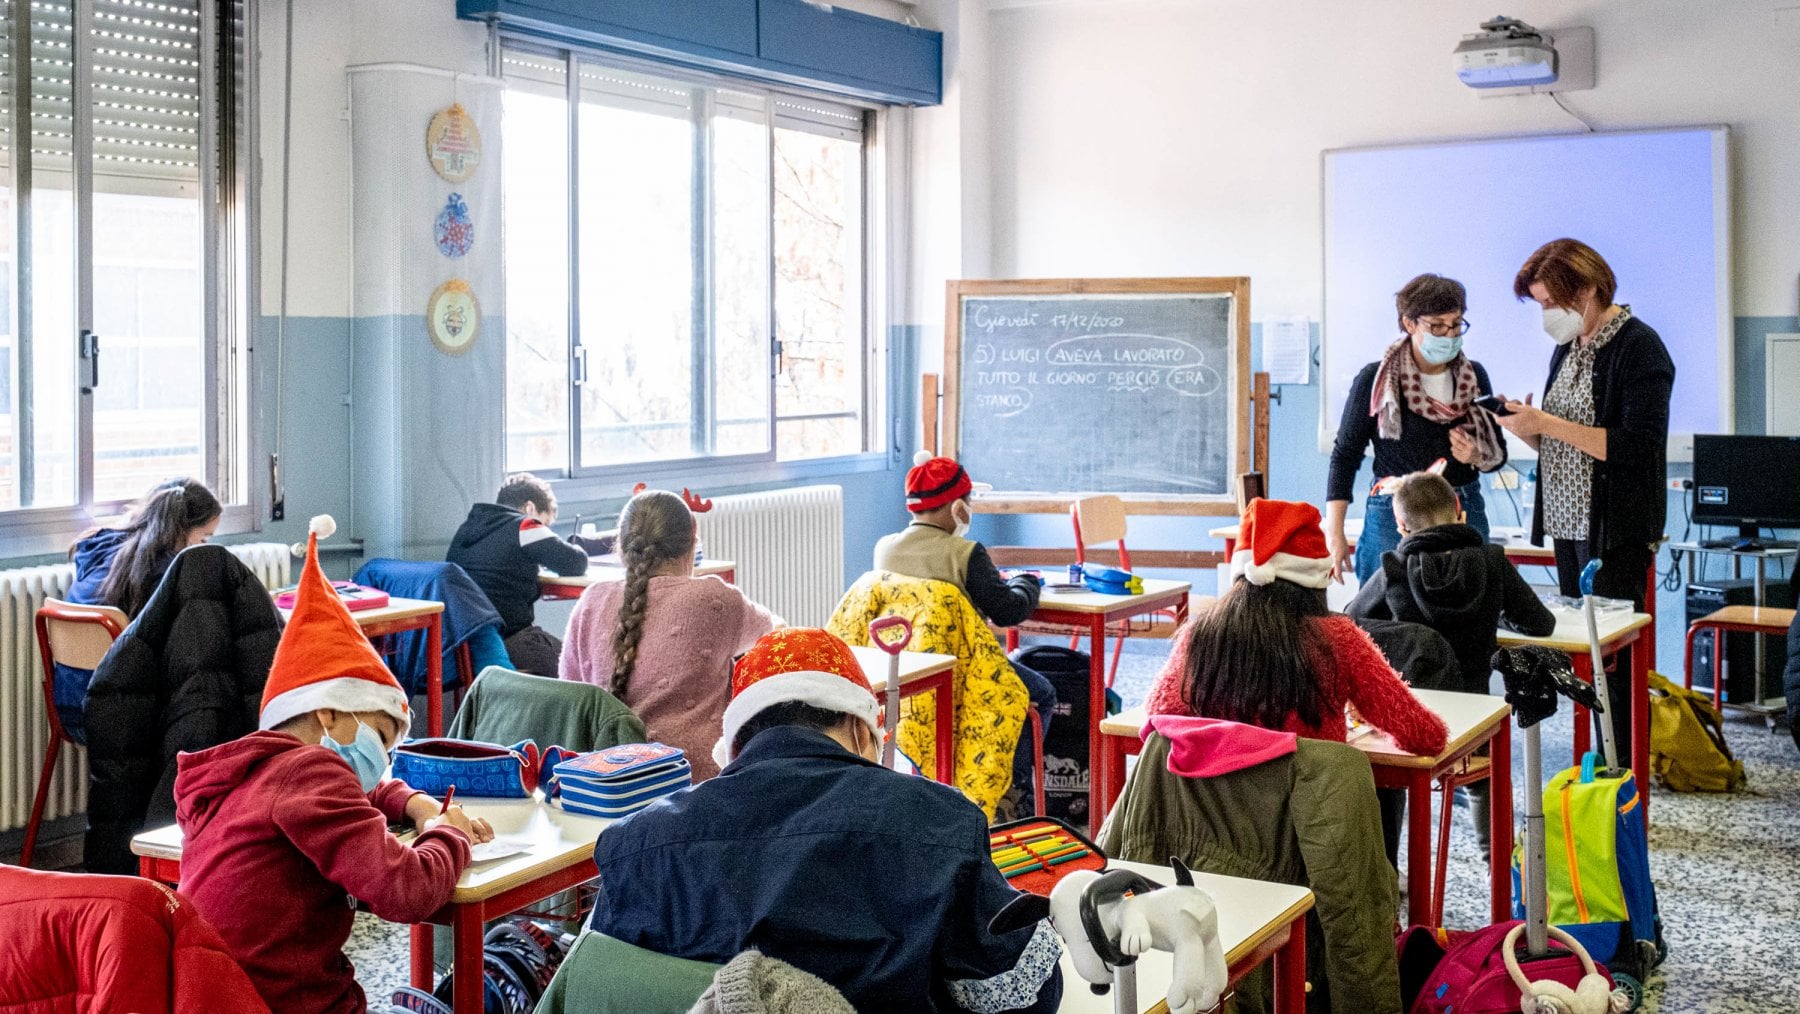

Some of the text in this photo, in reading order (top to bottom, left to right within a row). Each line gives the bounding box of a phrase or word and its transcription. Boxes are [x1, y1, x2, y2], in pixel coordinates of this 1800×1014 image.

[1050, 311, 1124, 332] 17/12/2020
[975, 343, 1185, 365] 5) LUIGI AVEVA LAVORATO
[977, 371, 1020, 385] TUTTO
[1028, 371, 1039, 384] IL
[1047, 371, 1096, 385] GIORNO
[1174, 370, 1205, 385] ERA
[1044, 769, 1089, 788] NSDALE
